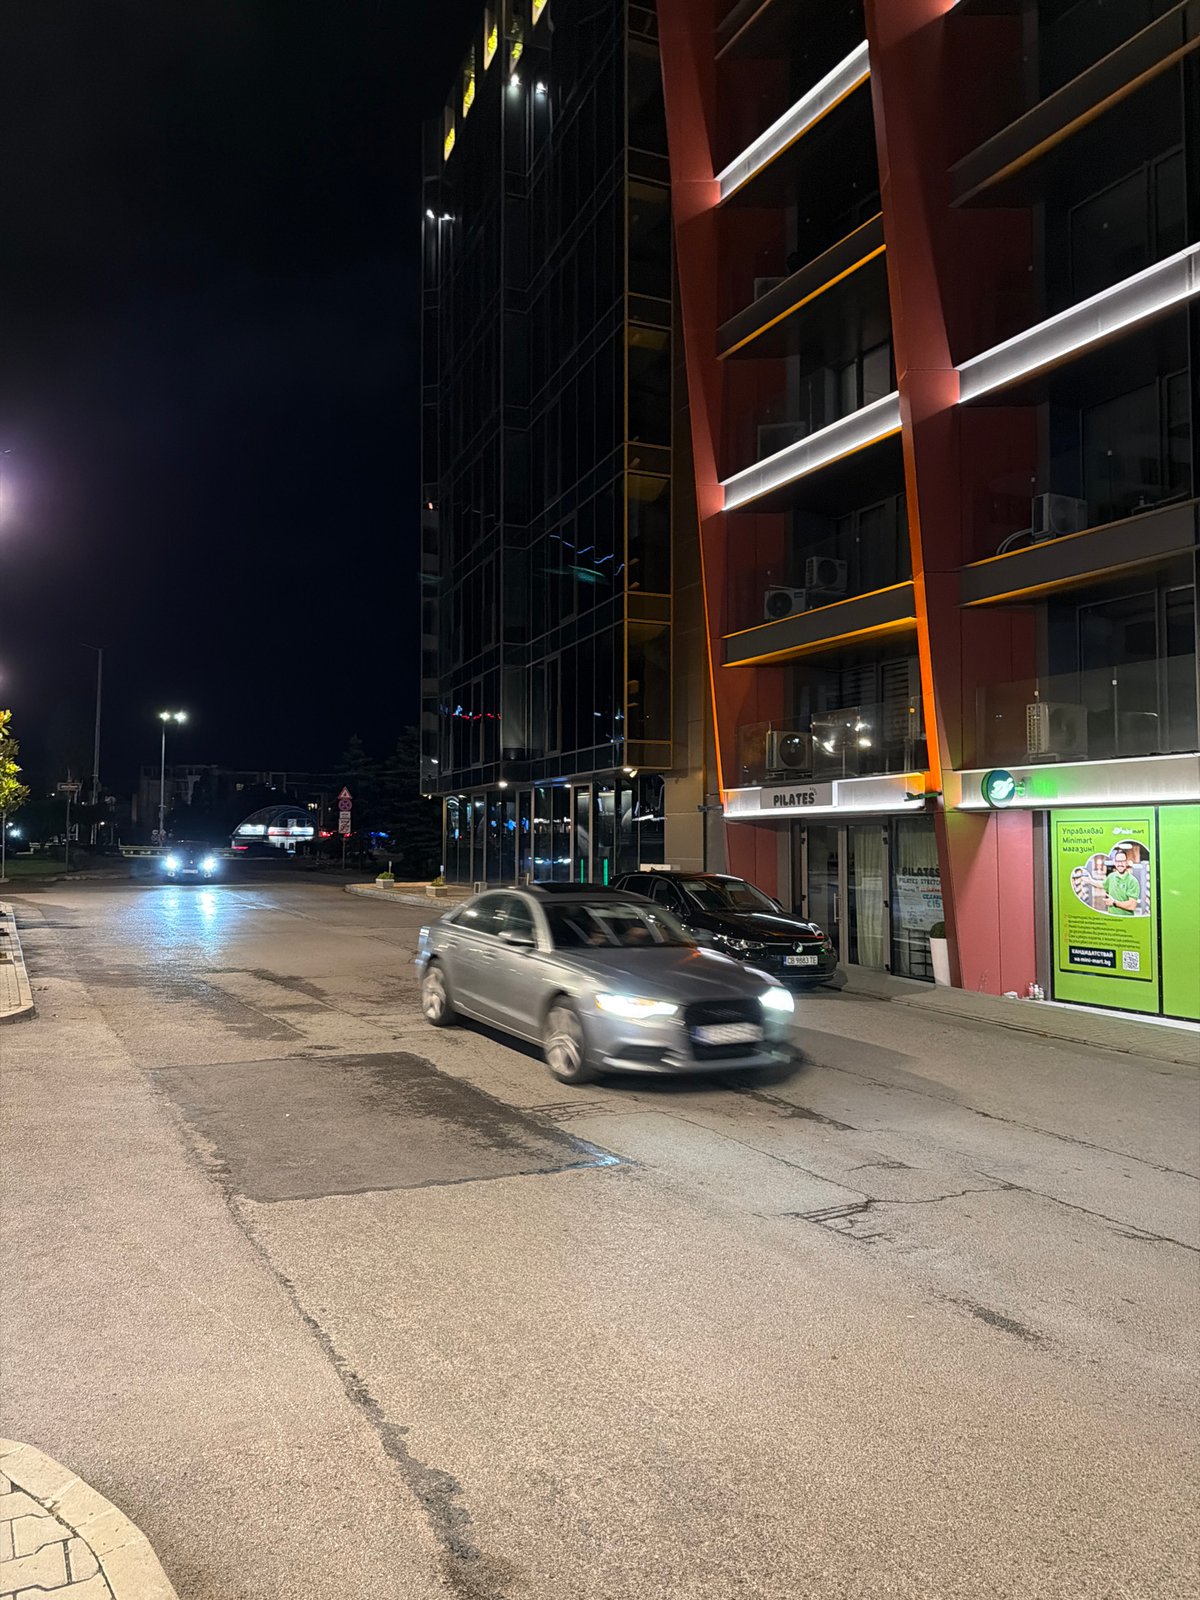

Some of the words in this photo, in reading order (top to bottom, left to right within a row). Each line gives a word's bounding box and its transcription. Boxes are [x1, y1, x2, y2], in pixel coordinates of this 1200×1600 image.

[773, 791, 815, 807] PILATES
[1062, 826, 1104, 835] Управлявай
[1062, 846, 1095, 854] магазин!
[902, 866, 940, 877] PILATES
[1071, 948, 1114, 958] КАНДИДАТСТВАЙ
